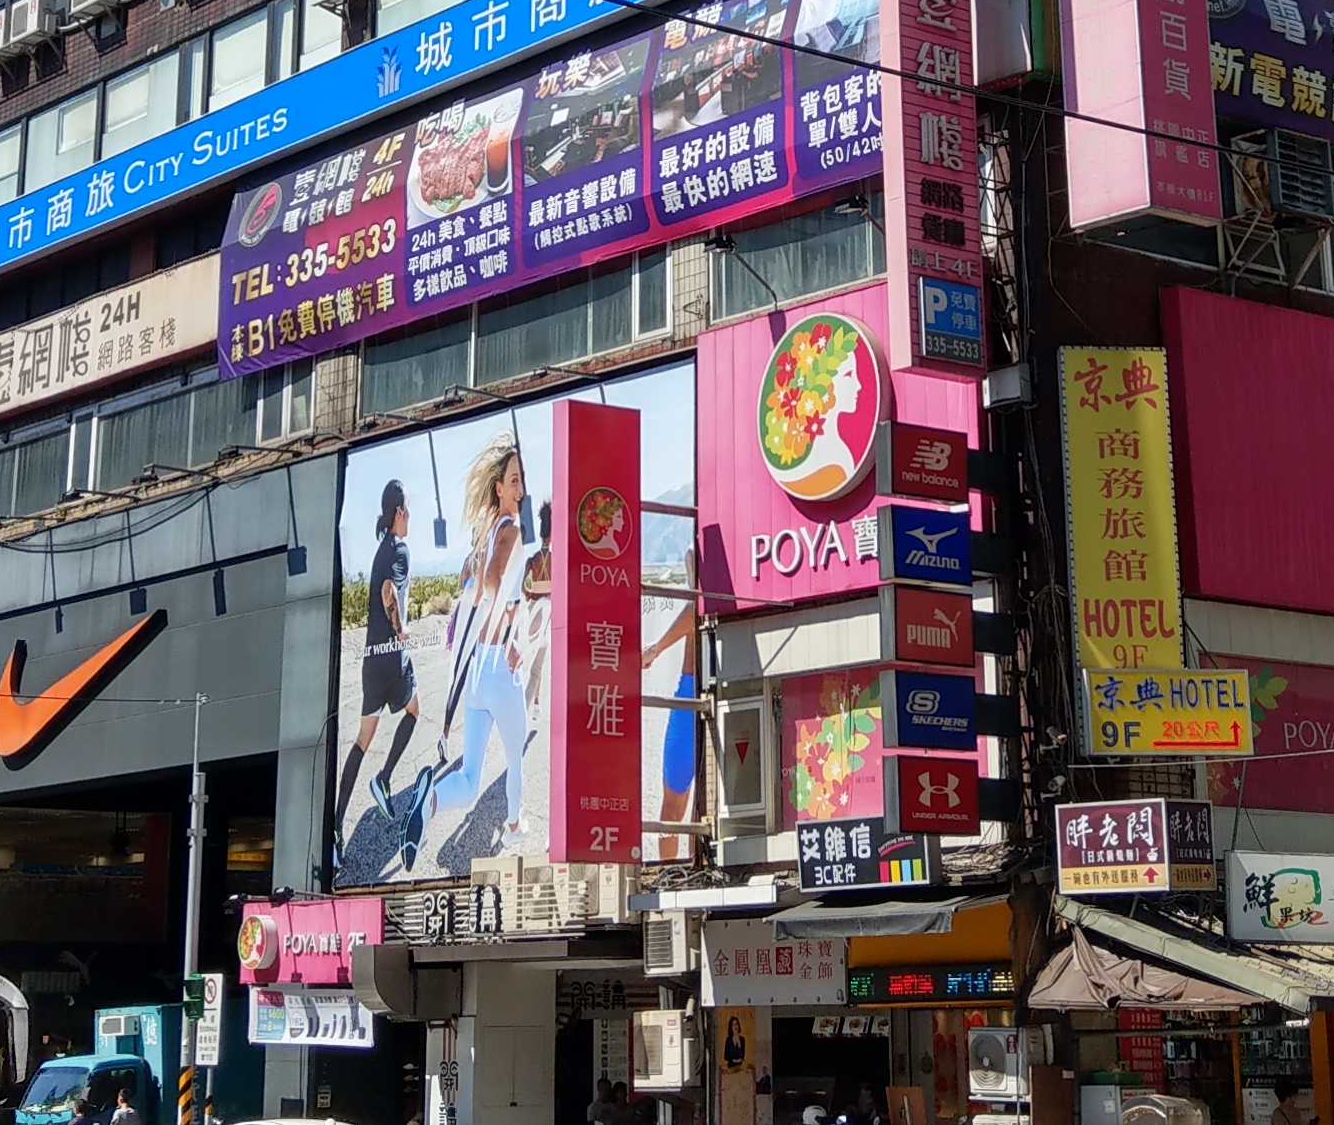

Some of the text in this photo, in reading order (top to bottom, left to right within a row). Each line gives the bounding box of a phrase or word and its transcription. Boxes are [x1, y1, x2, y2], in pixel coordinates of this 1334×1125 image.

[535, 49, 593, 99] 玩樂
[415, 98, 465, 144] 吃喝
[372, 132, 405, 166] 4F
[658, 113, 777, 179] 最好的設備
[660, 152, 778, 214] 最快的網速
[528, 168, 637, 228] 最新音響設備
[99, 291, 141, 333] 24H
[925, 286, 948, 325] P
[950, 291, 977, 312] 免費
[951, 312, 978, 333] 停車
[97, 317, 177, 372] 網路客棧
[926, 335, 980, 360] 335-5533
[1073, 356, 1160, 414] 京典
[902, 470, 959, 488] new balance
[1094, 427, 1150, 583] 商務旅館
[751, 520, 848, 579] POYA
[579, 564, 631, 589] POYA
[1084, 596, 1176, 639] HOTEL
[906, 624, 951, 649] PUMA
[1112, 643, 1149, 669] 9F
[586, 619, 625, 737] 寶雅
[911, 714, 970, 728] SKECHERS
[1102, 721, 1142, 749] 9F
[579, 795, 630, 813] 桃園中正店
[588, 827, 620, 852] 2F
[800, 822, 872, 863] 艾維信
[814, 863, 857, 885] 3C配件
[283, 934, 317, 954] POYA
[798, 940, 833, 958] 珠寶
[713, 948, 773, 977] 金鳳凰
[798, 962, 833, 980] 金飾
